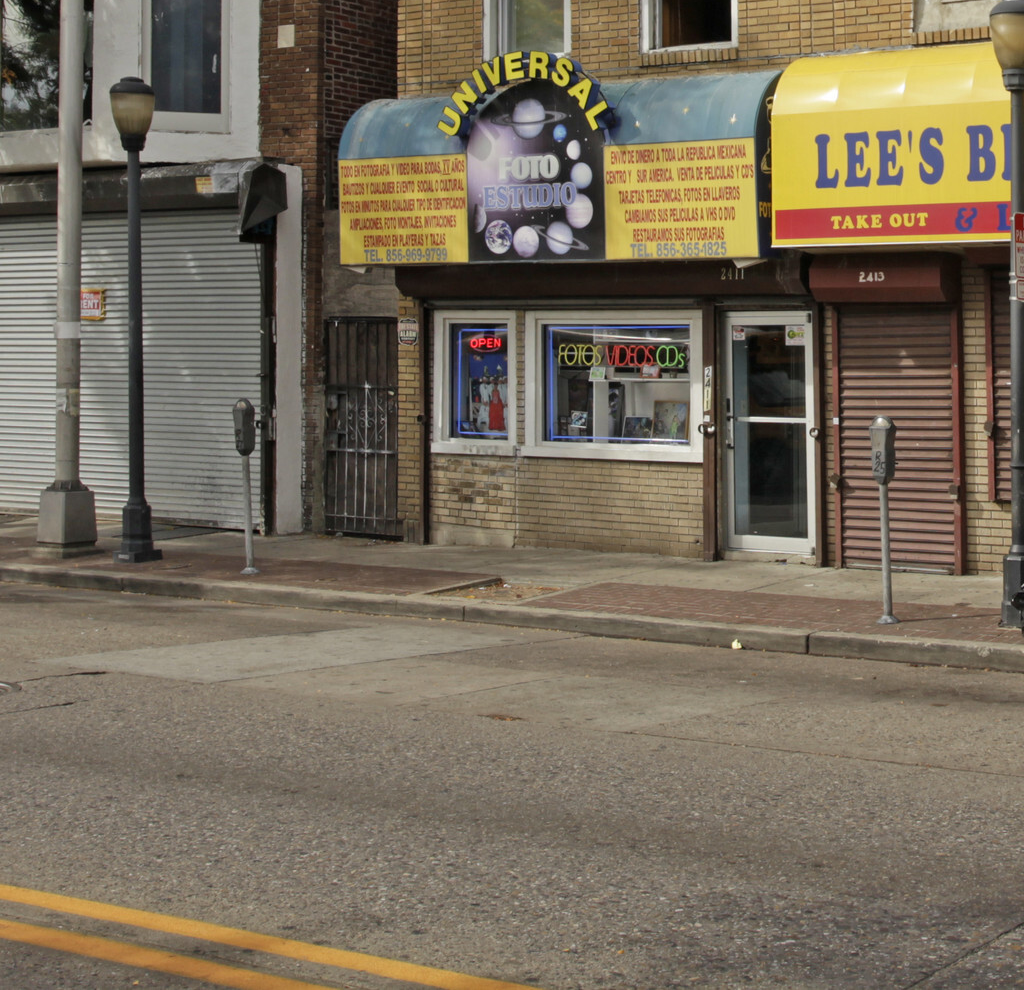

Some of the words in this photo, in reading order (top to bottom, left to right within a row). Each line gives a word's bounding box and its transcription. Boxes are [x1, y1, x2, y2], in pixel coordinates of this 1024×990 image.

[437, 51, 608, 136] UNIVERSAL
[611, 150, 626, 165] ENVIO
[628, 150, 634, 164] DE
[636, 149, 654, 164] DINERO
[656, 149, 660, 162] A
[661, 148, 676, 162] TODA
[677, 147, 685, 161] LA
[686, 146, 716, 161] REPUBLICA
[717, 144, 746, 159] MEXICANA
[815, 127, 944, 188] LEE'S
[341, 165, 353, 178] TODO
[354, 165, 360, 177] EN
[361, 163, 390, 177] FOTOGRAFIA
[391, 163, 395, 176] Y
[396, 162, 410, 176] VIDEO
[411, 162, 423, 175] PARA
[442, 159, 451, 175] XV
[451, 158, 464, 173] AÑOS
[500, 154, 560, 181] FOTO
[606, 170, 627, 185] CENTRO
[628, 169, 632, 183] Y
[636, 169, 648, 183] SUR
[677, 167, 695, 181] VENTA
[696, 167, 704, 181] DE
[704, 165, 734, 180] PELICULAS
[736, 165, 740, 179] Y
[742, 164, 754, 179] CD'S
[370, 181, 395, 195] CUALQUIER
[396, 180, 414, 194] EVENTO
[417, 179, 434, 193] SOCIAL
[440, 178, 464, 192] CULTURAL
[619, 190, 644, 204] TARJETAS
[684, 187, 702, 202] FOTOS
[703, 187, 710, 201] EN
[712, 186, 740, 201] LLAVEROS
[426, 197, 432, 210] DE
[483, 182, 577, 209] ESTUDIO
[384, 216, 396, 229] FOTO
[625, 209, 656, 223] CAMBIAMOS
[658, 208, 668, 222] SUS
[670, 207, 698, 222] PELICULAS
[700, 207, 704, 221] A
[706, 206, 717, 221] VHS
[718, 206, 722, 220] O
[724, 206, 736, 220] DVD
[831, 213, 882, 229] TAKE
[889, 212, 928, 227] OUT
[955, 207, 978, 232] &
[364, 234, 390, 248] ESTAMPADO
[392, 234, 398, 247] EN
[400, 234, 424, 247] PLAYERAS
[425, 233, 428, 246] Y
[430, 233, 446, 246] TAZAS
[633, 228, 672, 242] RESTAURAMOS
[674, 227, 684, 241] SUS
[686, 226, 724, 241] FOTOGRAFIAS
[364, 249, 384, 262] TEL.
[386, 248, 448, 262] 856-969-9799
[630, 243, 653, 258] TEL.
[656, 241, 727, 257] 856-365-1825
[1020, 256, 1024, 264] IS
[720, 268, 744, 280] 2411
[859, 272, 885, 283] 2413
[80, 299, 98, 309] ENT
[470, 337, 502, 348] OPEN
[558, 344, 602, 366] FOTOS
[605, 345, 655, 367] VIDEOS
[704, 368, 712, 410] 2411
[874, 460, 886, 474] 25
